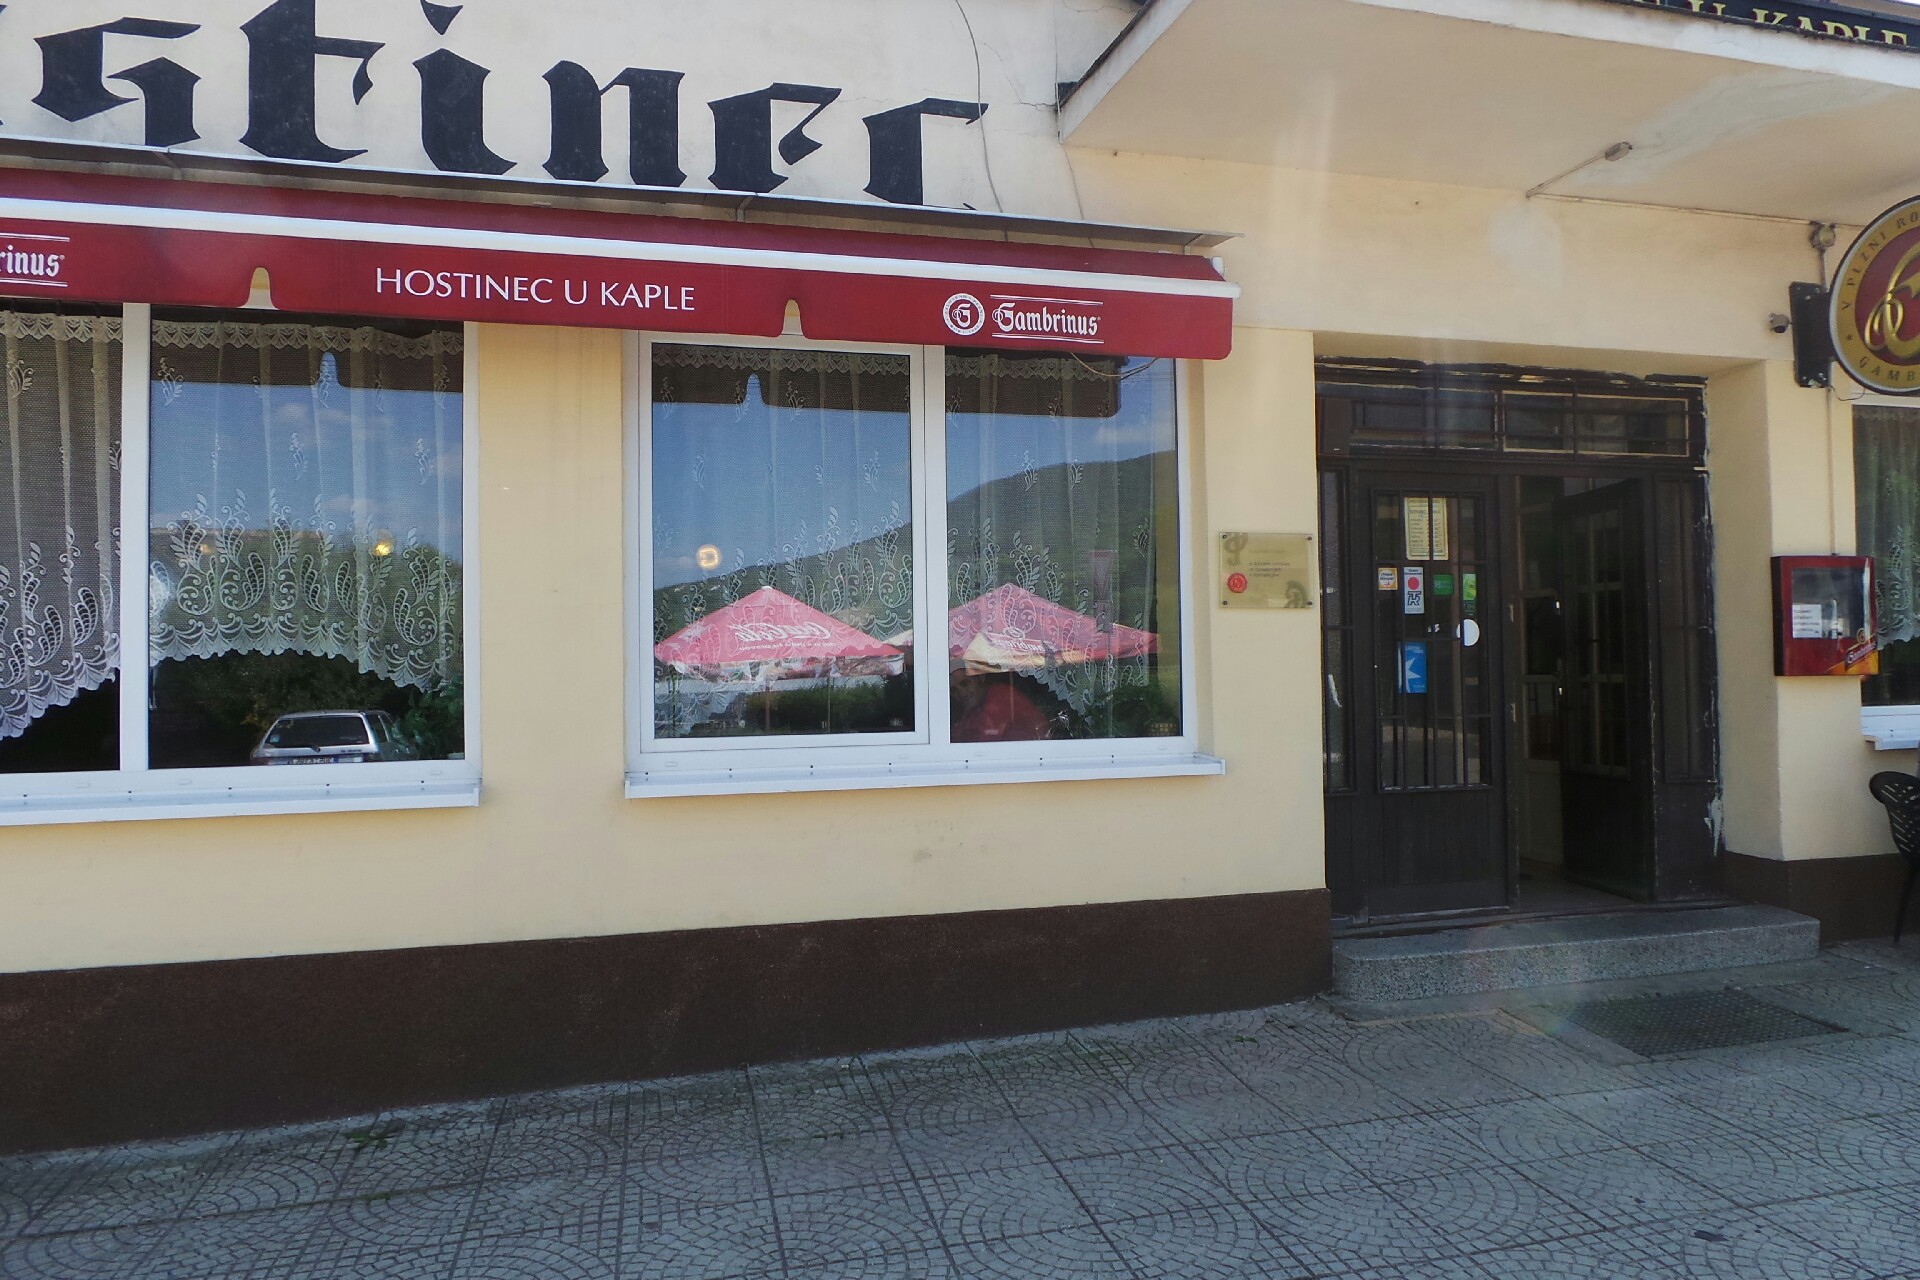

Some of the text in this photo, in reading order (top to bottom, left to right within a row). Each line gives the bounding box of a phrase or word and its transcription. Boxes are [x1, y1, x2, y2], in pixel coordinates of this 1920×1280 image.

[0, 0, 988, 211] stinec
[375, 266, 696, 313] HOSTINEC U KAPLE
[991, 302, 1099, 336] Gambrinus
